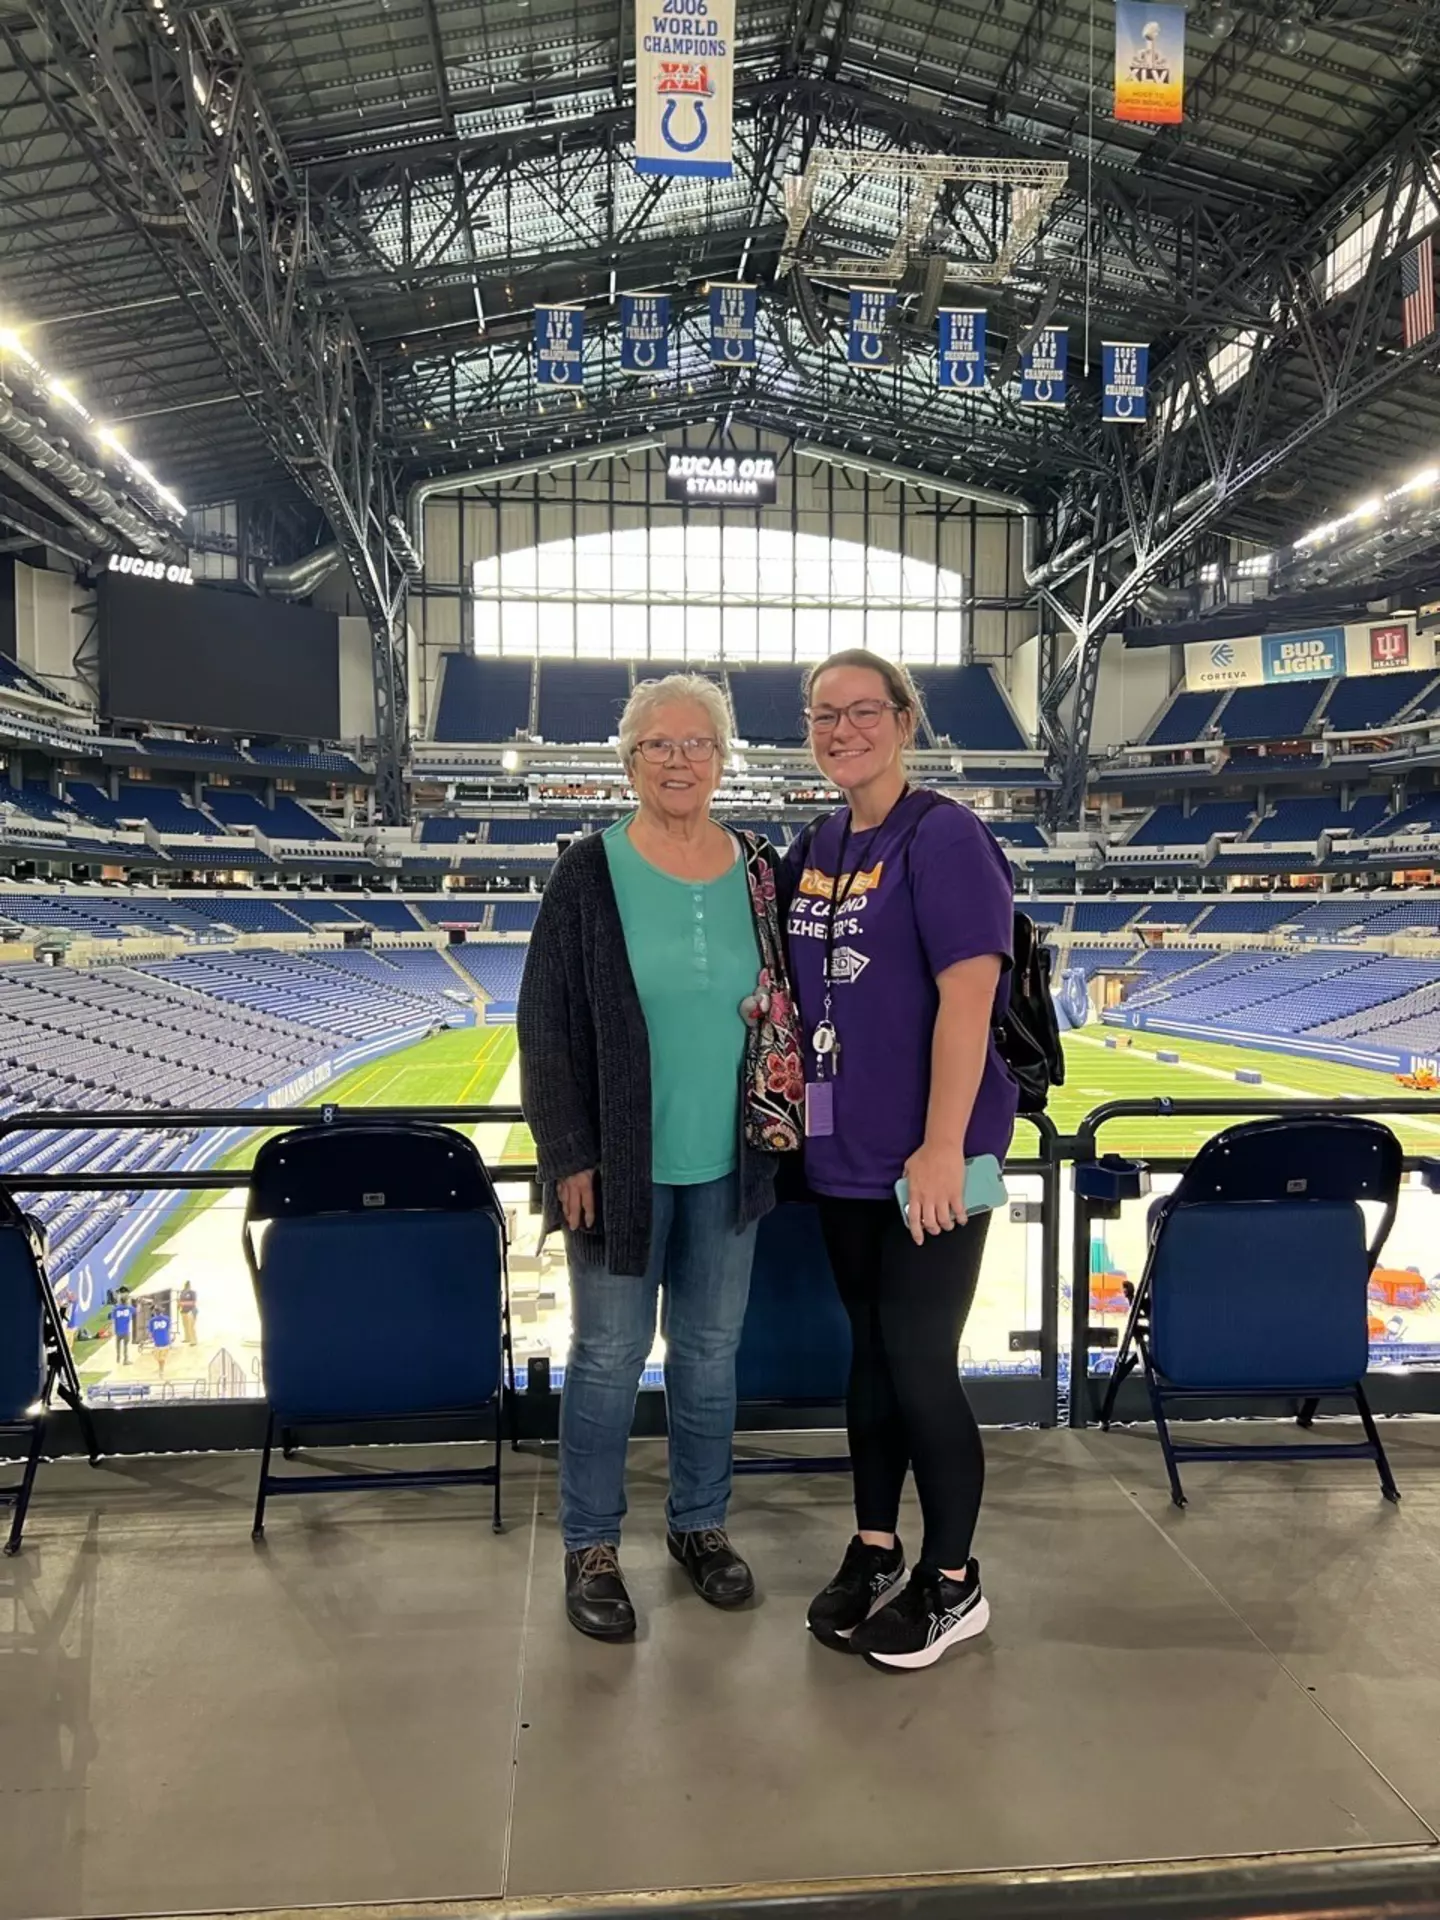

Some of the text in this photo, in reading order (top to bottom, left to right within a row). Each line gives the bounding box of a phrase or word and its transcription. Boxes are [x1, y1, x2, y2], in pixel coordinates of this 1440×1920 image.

[663, 0, 708, 15] 2006
[652, 16, 718, 36] WORLD
[644, 36, 726, 57] CHAMPIONS
[719, 300, 745, 317] AFC
[860, 307, 886, 322] AFC
[631, 312, 658, 327] AFC
[546, 322, 573, 339] AFC
[951, 327, 974, 341] AFC
[1031, 341, 1057, 358] AFC
[1114, 358, 1137, 374] AFC
[1114, 374, 1136, 385] SOUTH
[668, 455, 775, 480] LUCAS OIL
[686, 477, 758, 495] STADIUM
[108, 553, 194, 586] LUCAS OIL
[1281, 639, 1325, 660] BUD
[1273, 654, 1334, 676] LIGHT
[1200, 671, 1247, 682] CORTEVA
[323, 1107, 333, 1123] 8
